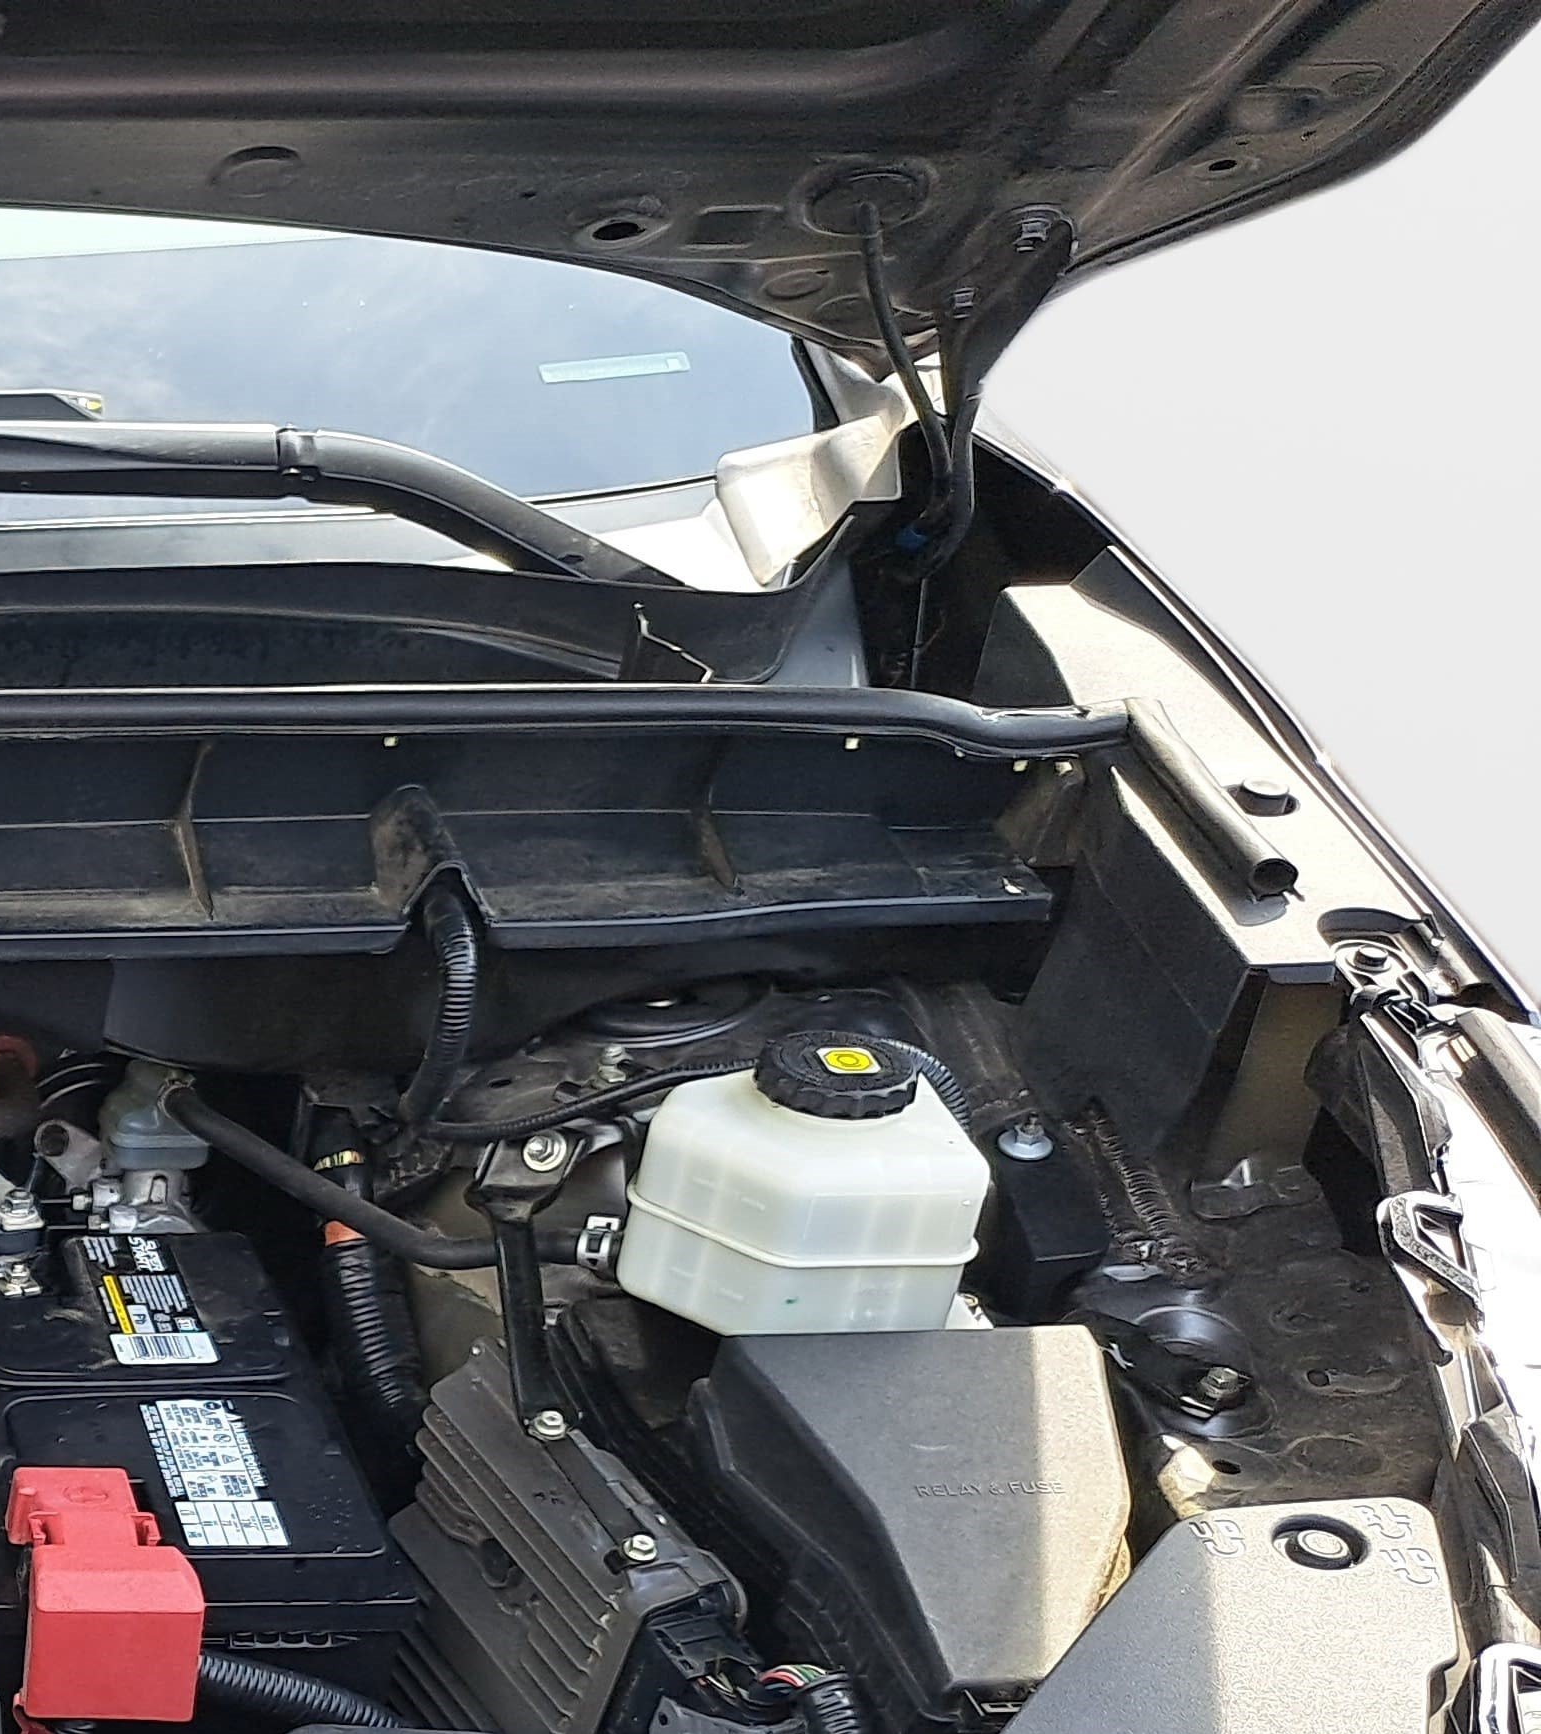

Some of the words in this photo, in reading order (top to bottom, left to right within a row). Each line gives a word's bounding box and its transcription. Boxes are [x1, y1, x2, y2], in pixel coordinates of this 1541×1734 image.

[914, 1483, 983, 1499] RELAY
[989, 1482, 1006, 1496] &
[1009, 1480, 1067, 1496] FUSE
